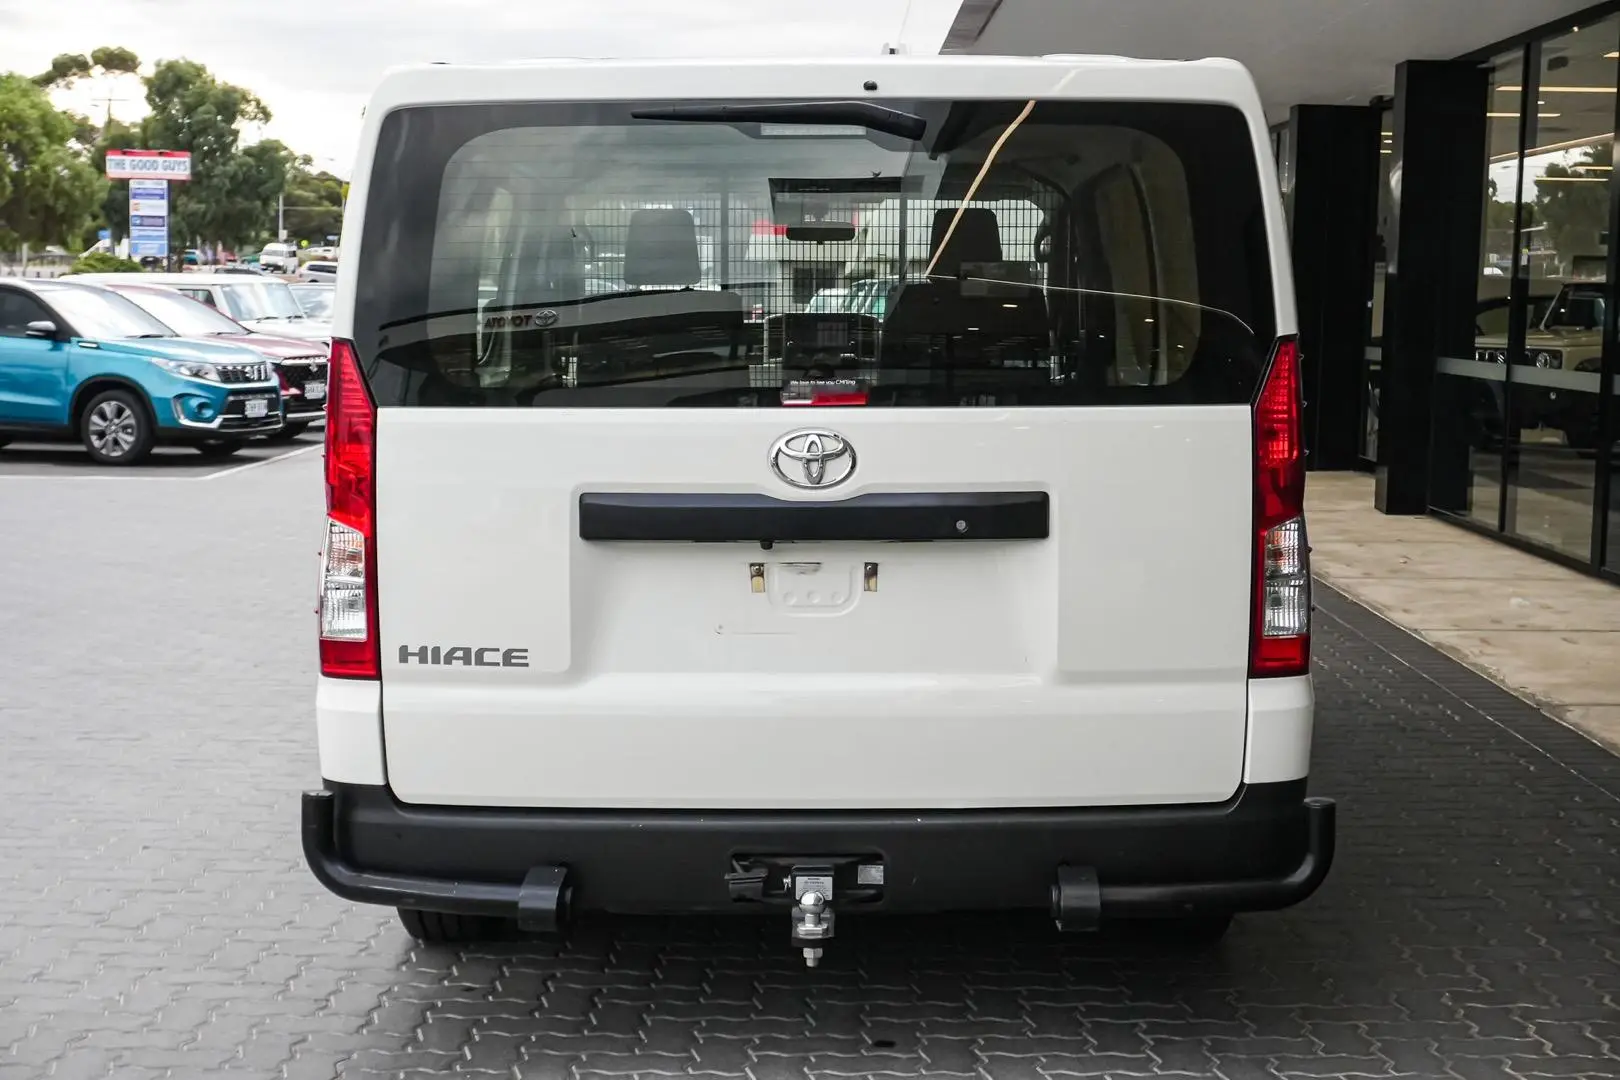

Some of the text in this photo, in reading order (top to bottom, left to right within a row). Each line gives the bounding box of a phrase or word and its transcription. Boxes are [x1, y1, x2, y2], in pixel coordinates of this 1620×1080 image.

[108, 159, 188, 172] THE GOOD GUYS
[398, 644, 530, 667] HIACE
